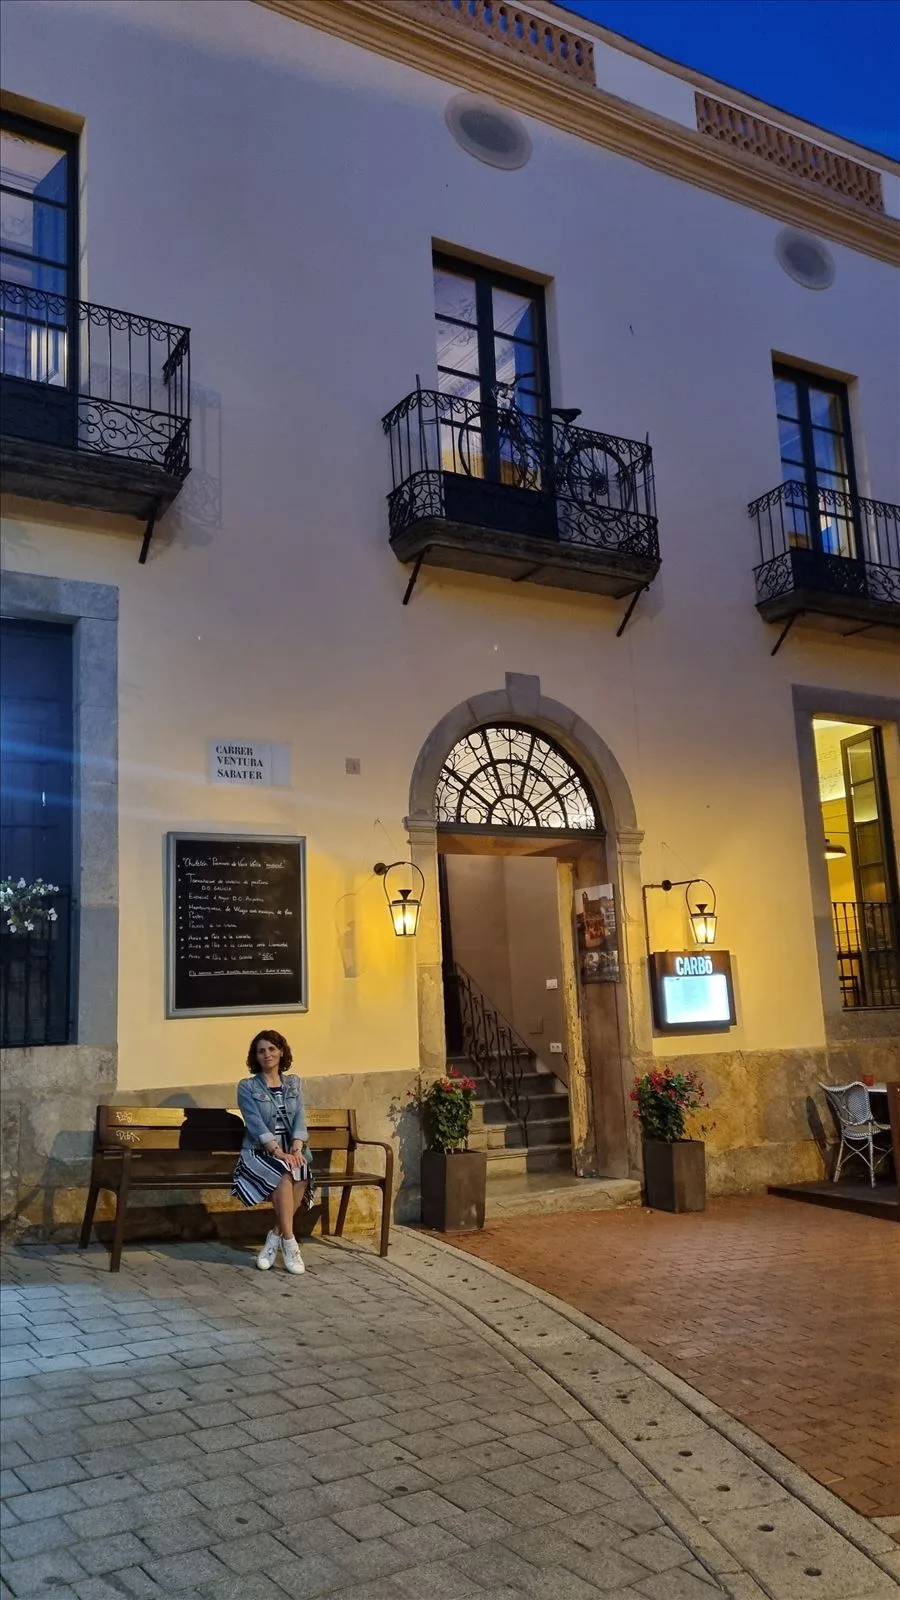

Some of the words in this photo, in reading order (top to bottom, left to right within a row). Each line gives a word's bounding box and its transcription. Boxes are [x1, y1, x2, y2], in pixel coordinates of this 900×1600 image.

[215, 745, 253, 756] CARRER
[217, 756, 264, 767] VENTURA
[217, 769, 262, 780] SABATER
